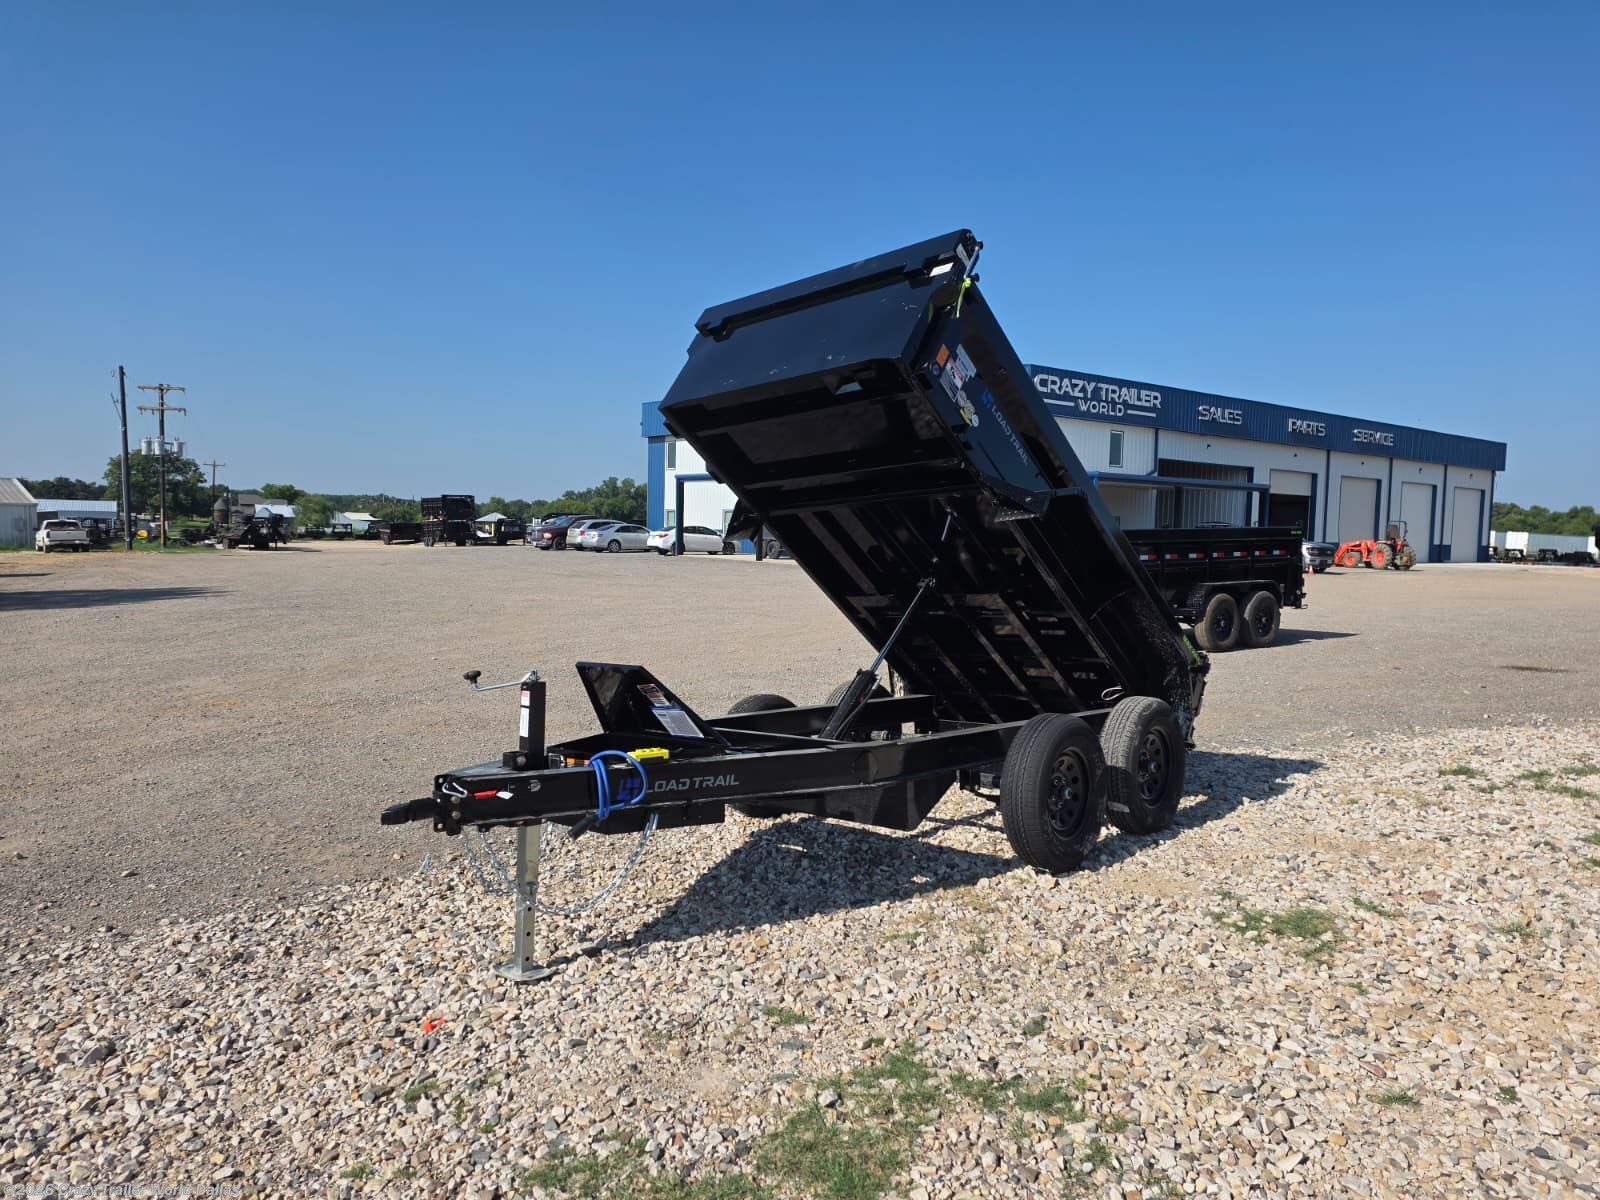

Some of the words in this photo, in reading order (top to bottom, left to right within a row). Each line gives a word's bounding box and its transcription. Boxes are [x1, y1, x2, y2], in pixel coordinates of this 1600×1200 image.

[1033, 374, 1096, 398] CRAZY
[1097, 383, 1161, 408] TRAILER
[1078, 399, 1125, 416] WORLD
[1198, 405, 1242, 425] SALES
[1288, 418, 1326, 437] PARTS
[1353, 428, 1394, 446] SERVICE
[693, 774, 740, 789] TRAIL
